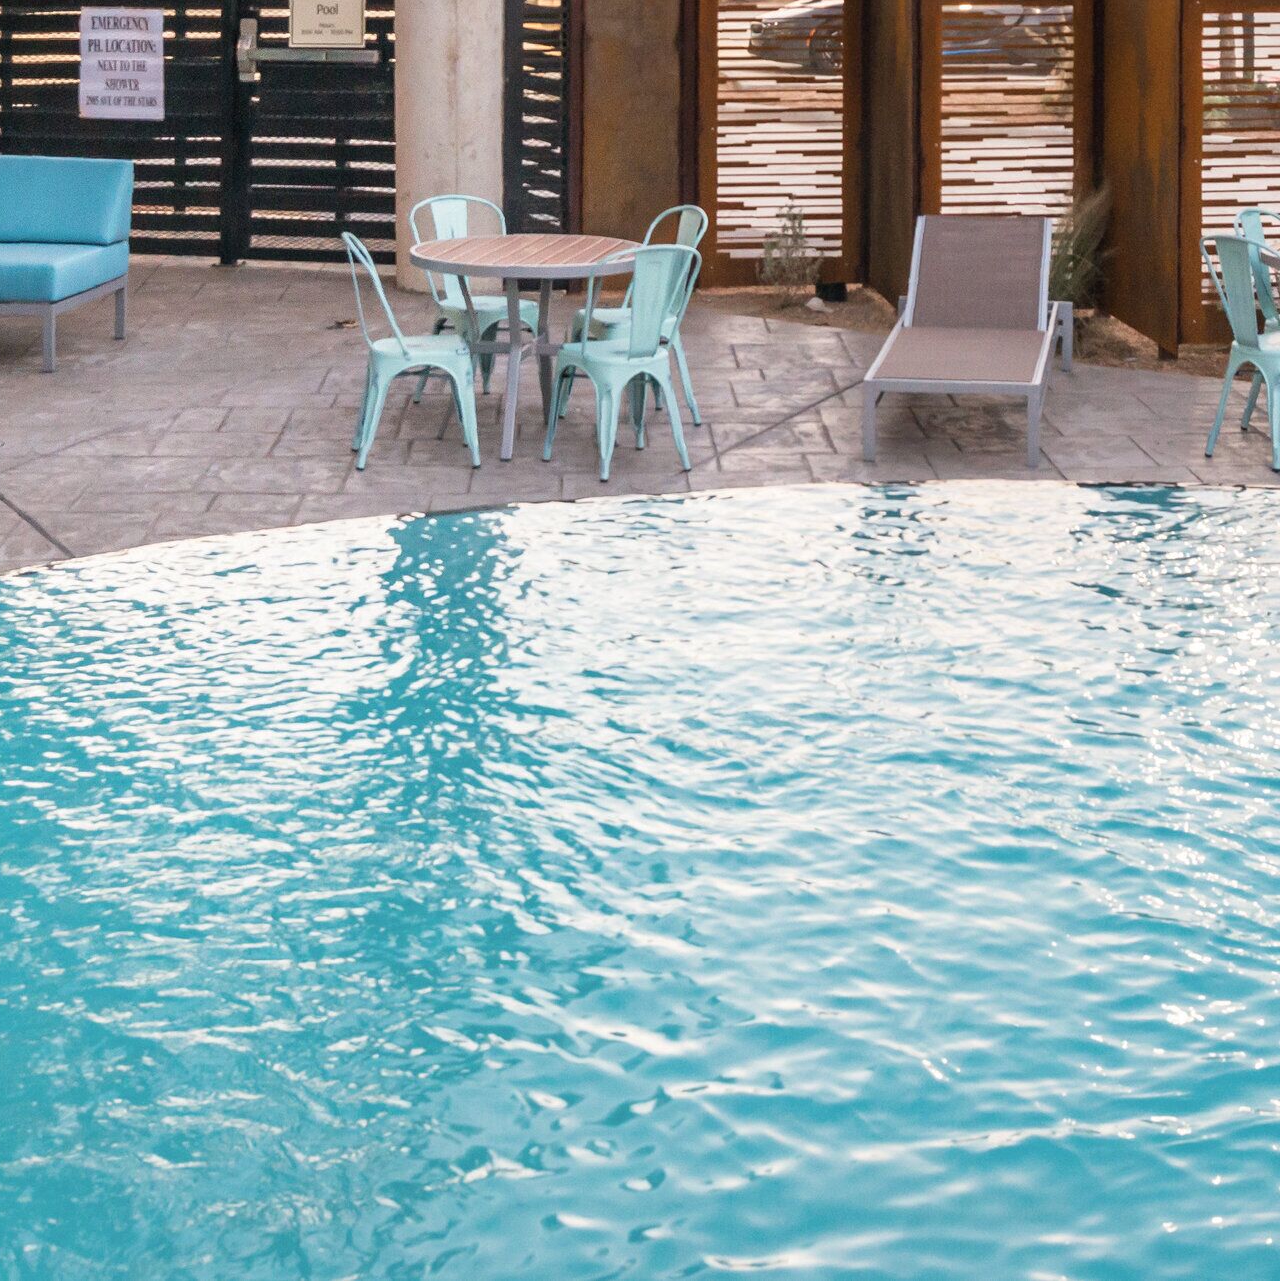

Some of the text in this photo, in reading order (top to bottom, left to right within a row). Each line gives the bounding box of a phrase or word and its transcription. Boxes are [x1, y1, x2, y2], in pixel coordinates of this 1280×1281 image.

[317, 4, 338, 15] Pool
[91, 16, 149, 31] EMERGENCY
[88, 39, 157, 54] PH. LOCATION:
[98, 60, 148, 72] NEXT TO THE
[104, 79, 140, 91] SHOWER
[113, 96, 121, 106] OF
[122, 96, 136, 106] THE
